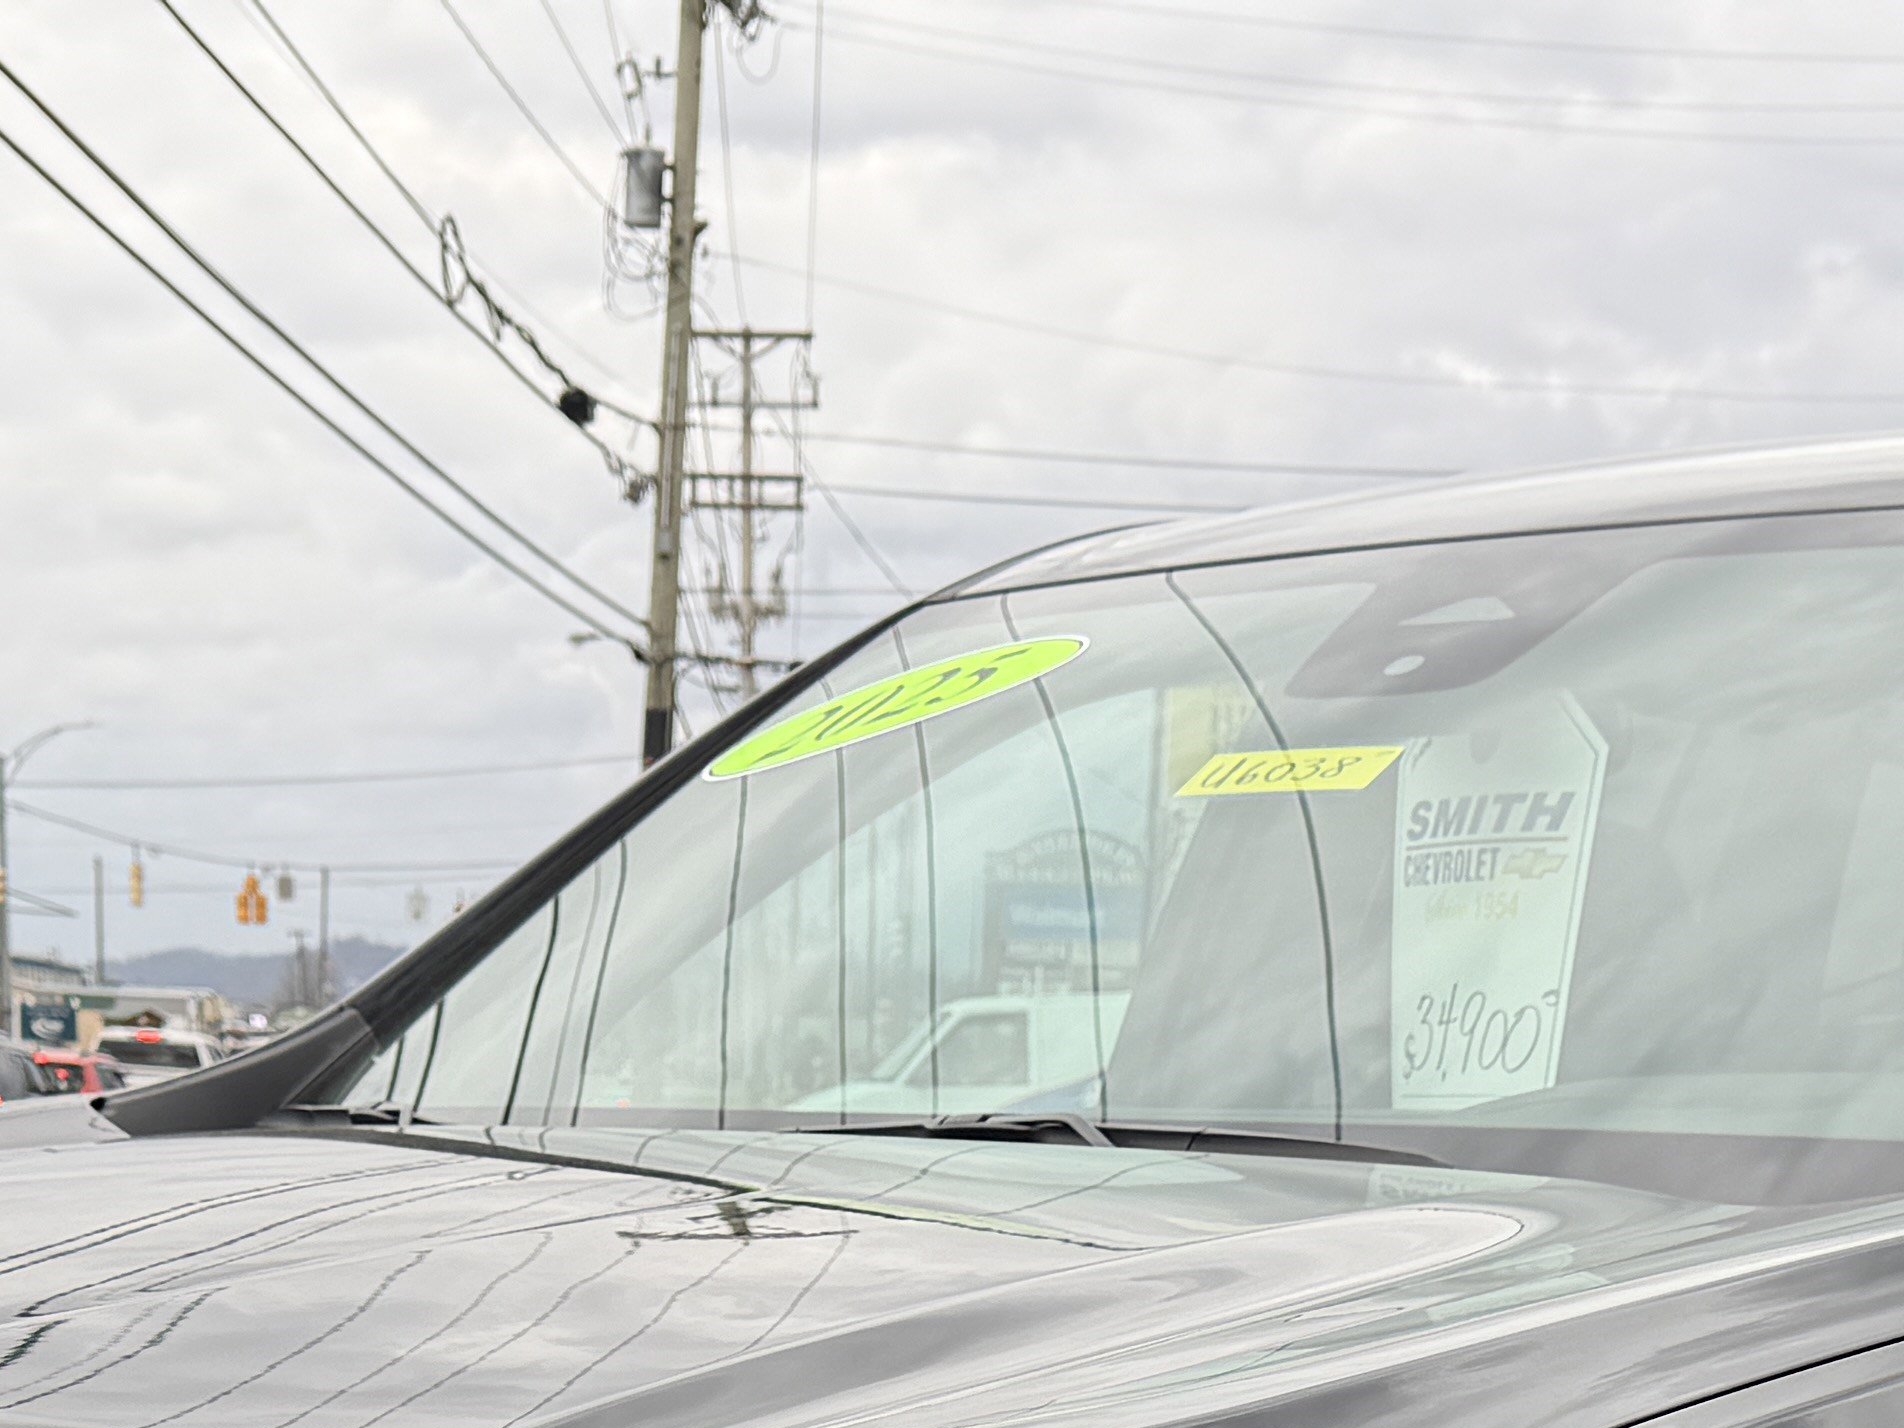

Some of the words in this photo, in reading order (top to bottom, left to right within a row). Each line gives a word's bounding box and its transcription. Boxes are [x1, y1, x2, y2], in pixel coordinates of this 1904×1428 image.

[746, 646, 1032, 768] 2025
[1407, 791, 1575, 841] SMITH
[1403, 847, 1501, 888] CHEVROLET
